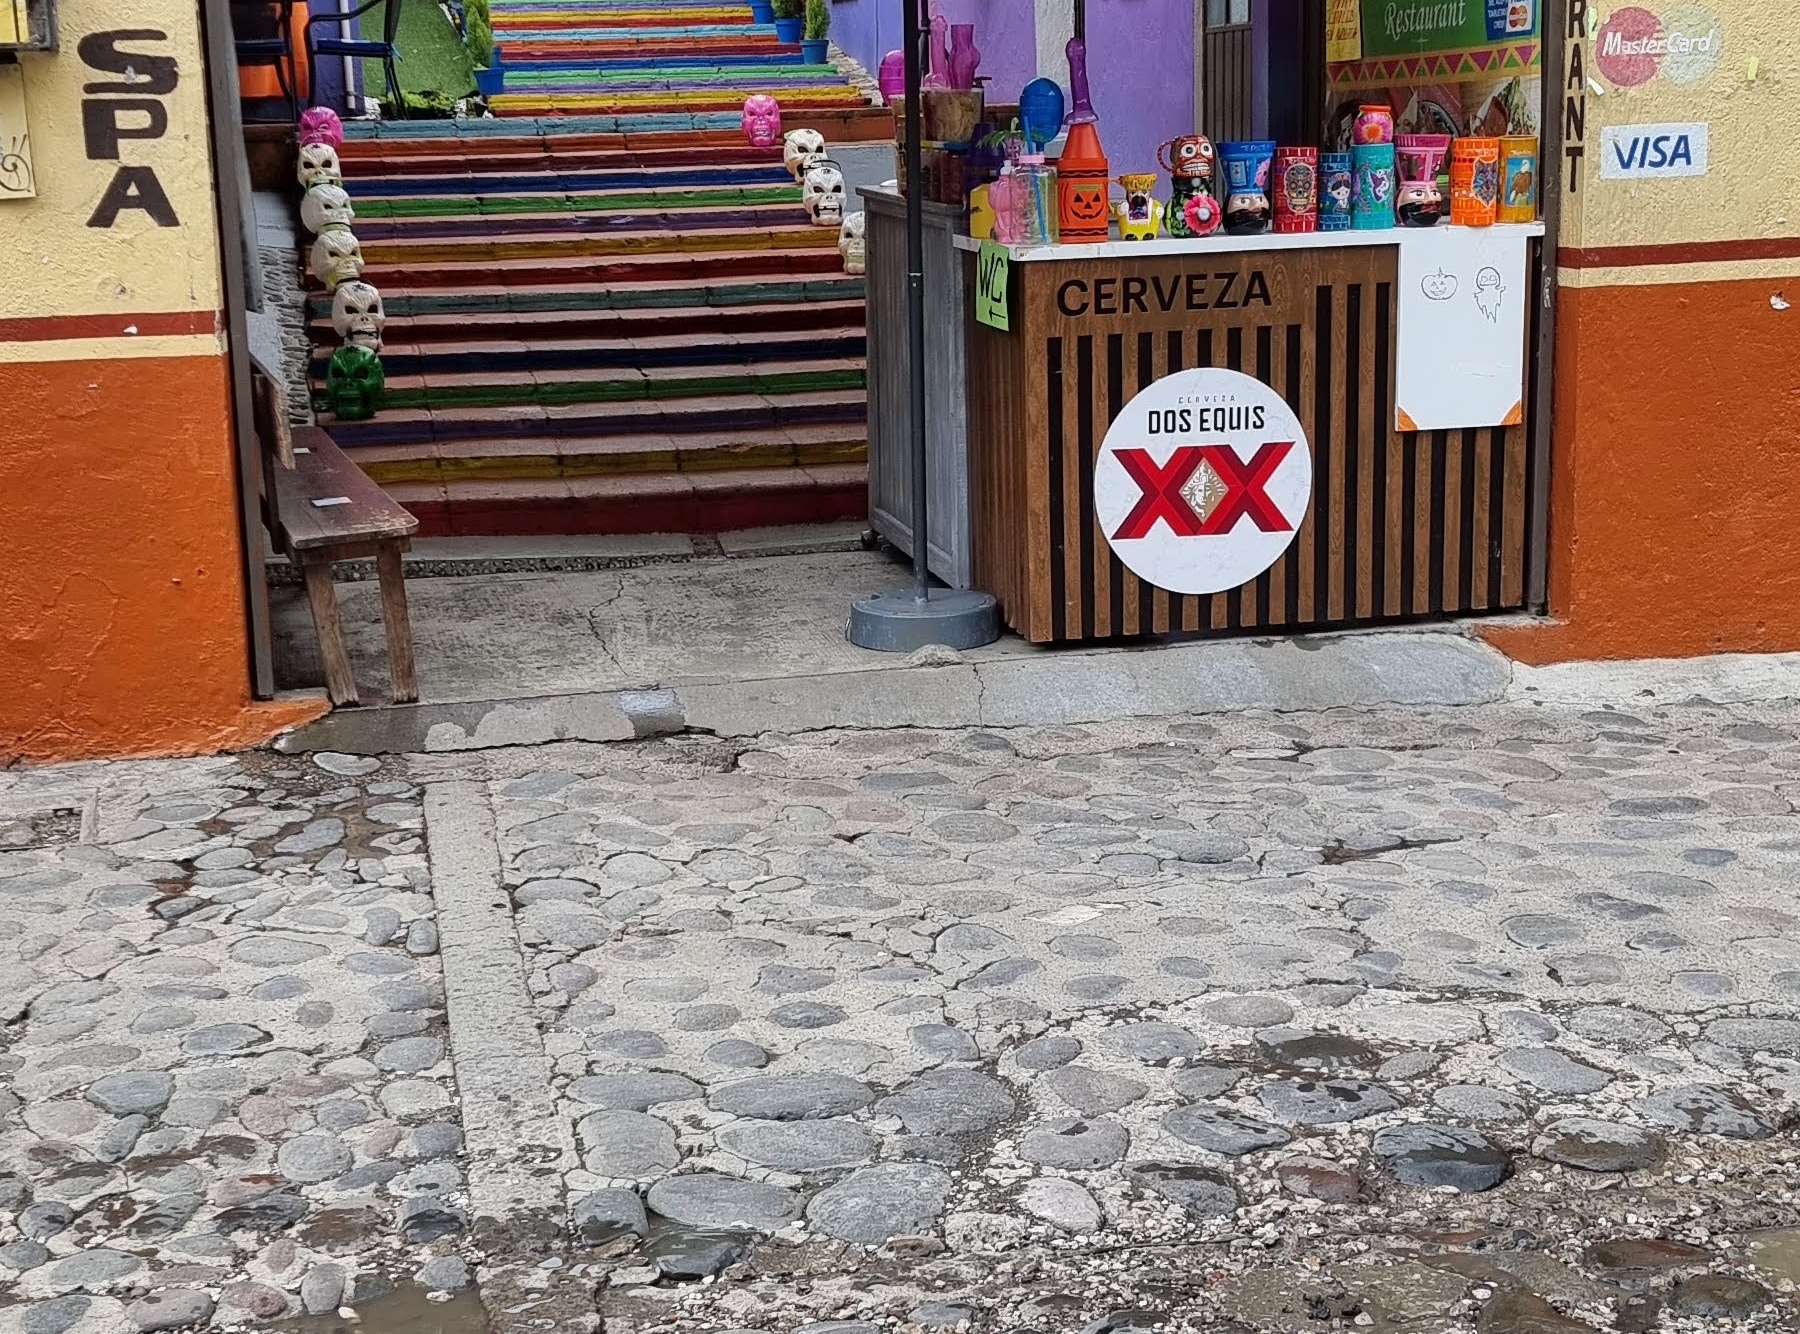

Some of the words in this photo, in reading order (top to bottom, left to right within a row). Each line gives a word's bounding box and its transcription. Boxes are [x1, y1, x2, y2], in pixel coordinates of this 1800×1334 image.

[77, 28, 181, 228] SPA
[1608, 134, 1692, 170] VISA
[978, 247, 1004, 304] WC
[1056, 270, 1272, 317] CERVEZA
[1147, 408, 1192, 435] DOS
[1198, 405, 1266, 433] EQUIS
[1110, 440, 1297, 541] XX
